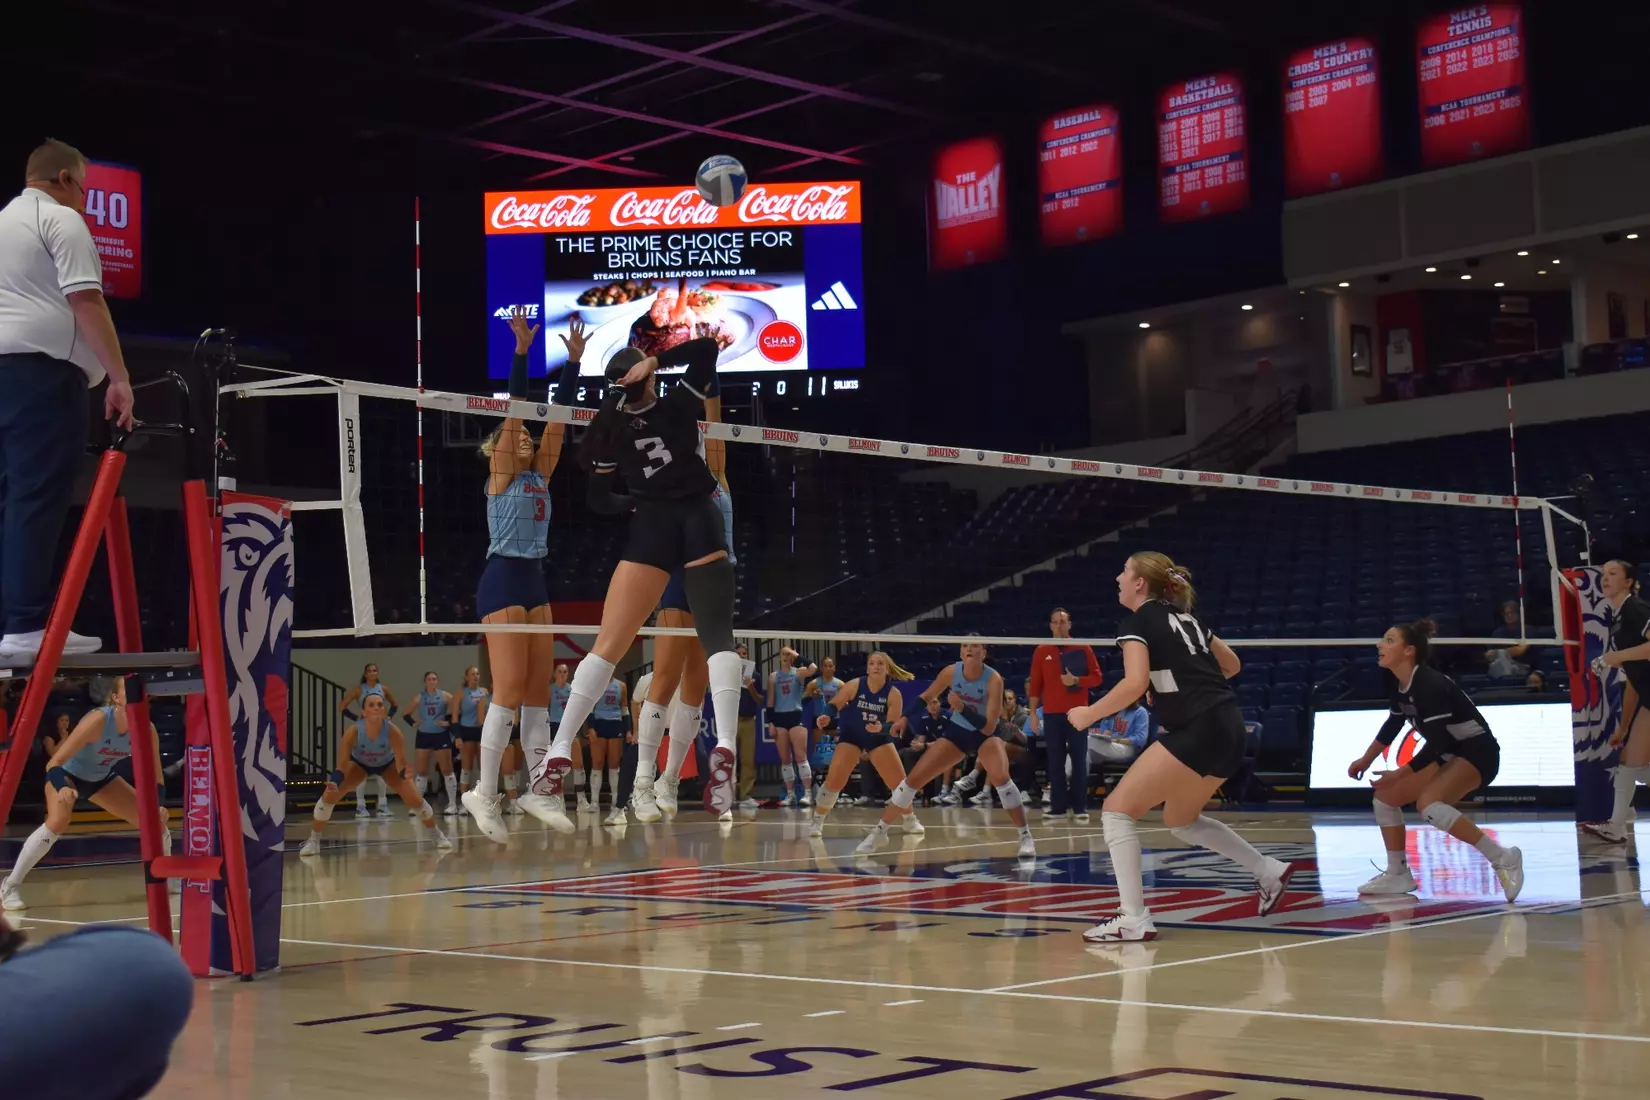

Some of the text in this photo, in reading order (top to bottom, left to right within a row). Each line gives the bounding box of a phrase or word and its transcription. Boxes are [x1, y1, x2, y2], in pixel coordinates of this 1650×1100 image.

[1450, 5, 1487, 24] MEN'S
[1447, 16, 1492, 36] TENNIS
[1427, 27, 1511, 54] CONFERENCE CHAMPIONS
[1313, 42, 1347, 59] MEN'S
[1446, 50, 1467, 64] 2014
[1288, 47, 1373, 77] CROSS COUNTRY
[1446, 61, 1468, 75] 2022
[1184, 76, 1216, 93] MEN'S
[1332, 78, 1352, 92] 2004
[1168, 83, 1233, 108] BASKETBALL
[1053, 110, 1101, 130] BASEBALL
[956, 171, 976, 184] THE
[935, 162, 1000, 220] VALLEY
[85, 189, 128, 229] 40
[491, 195, 596, 229] Coca-Cola
[738, 185, 853, 222] Coca-Cola
[556, 231, 792, 253] THE PRIME CHOICE FOR
[608, 249, 741, 268] BRUINS FANS
[631, 271, 658, 279] CHOPS
[665, 270, 704, 279] SEAFOOD
[763, 336, 796, 345] CHAR
[466, 396, 510, 413] BELMONT
[763, 428, 800, 443] BRUINS
[849, 438, 882, 451] BELMONT
[634, 437, 673, 479] 3
[927, 446, 960, 459] BRUINS
[1002, 453, 1031, 466] BELMONT
[1071, 460, 1100, 472] BRUINS
[534, 498, 546, 521] 3
[1168, 612, 1210, 655] 17
[857, 700, 886, 713] BELMONT
[188, 746, 212, 893] BELMOT
[454, 900, 1071, 937] BRUINS
[295, 1002, 1039, 1091] TRUIST
